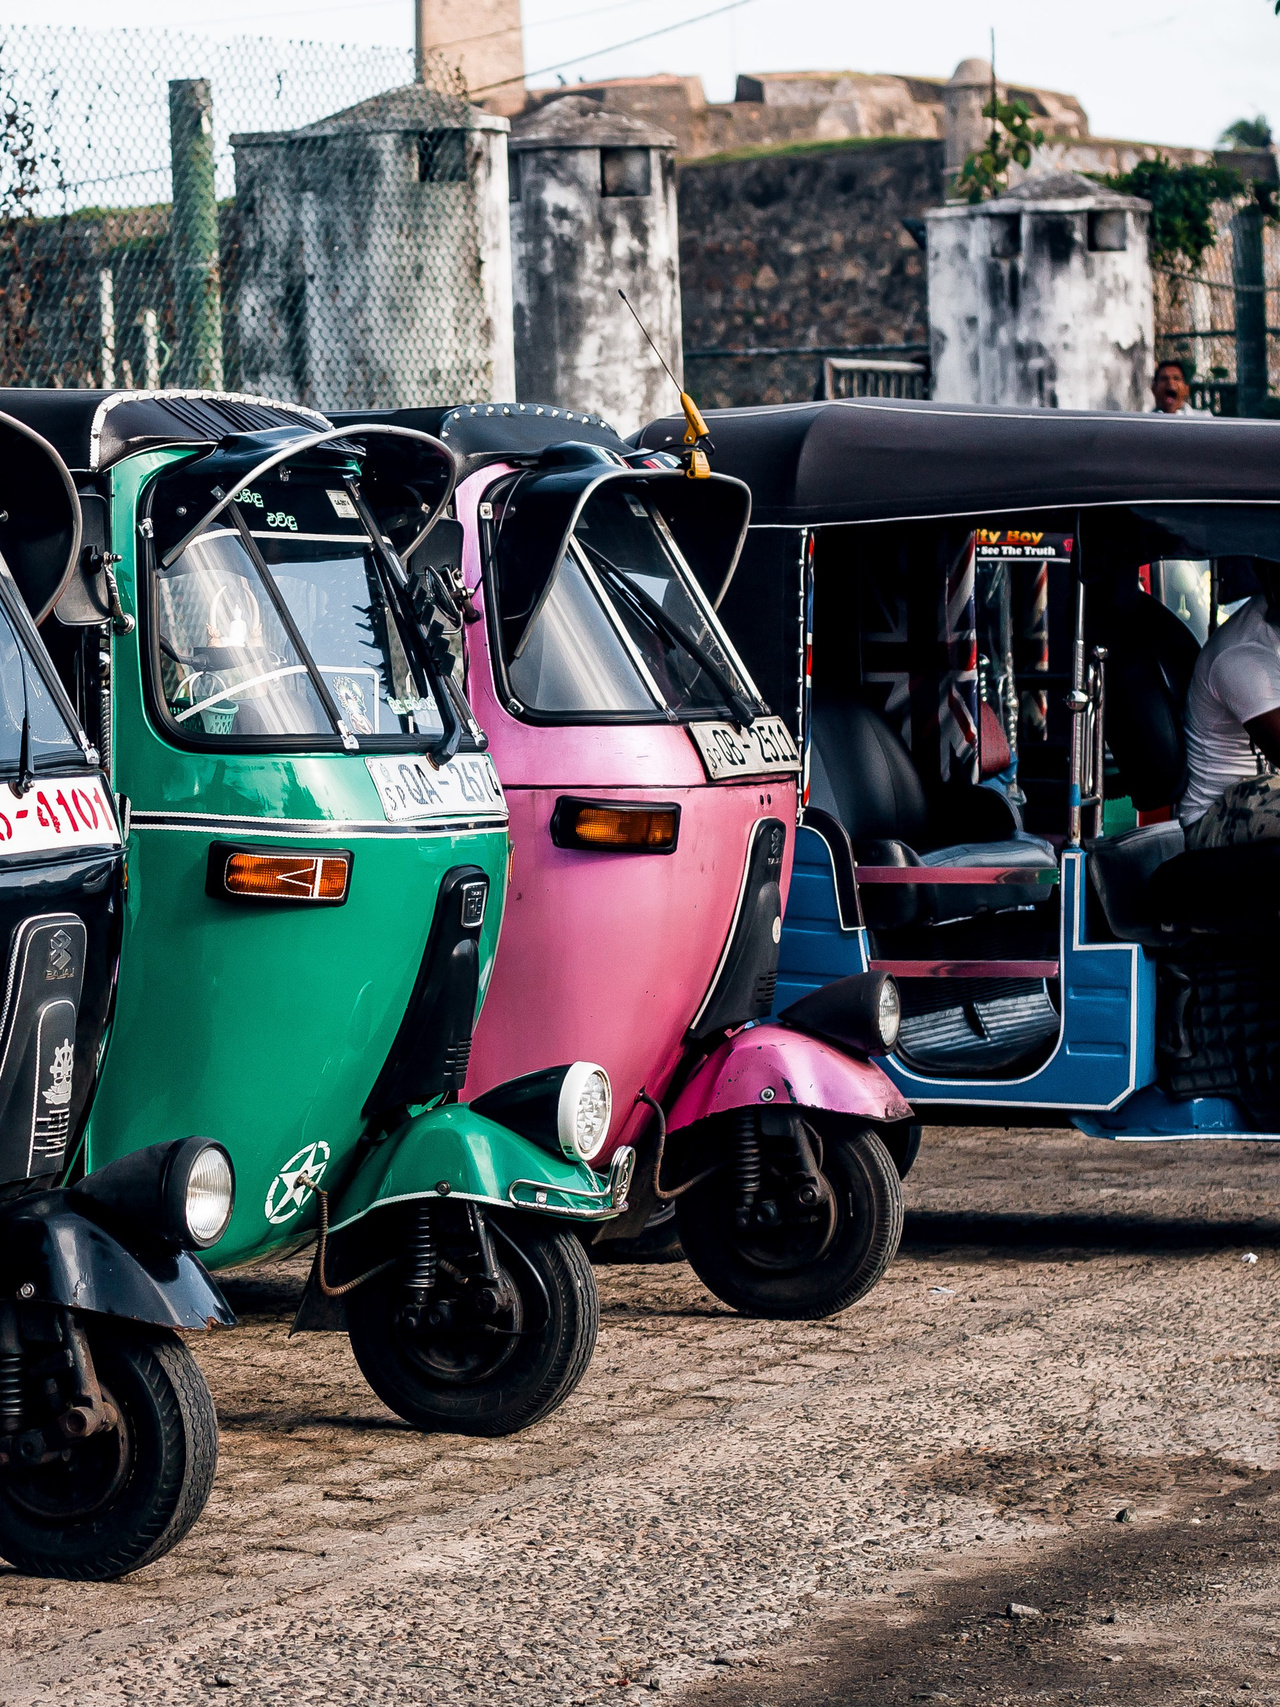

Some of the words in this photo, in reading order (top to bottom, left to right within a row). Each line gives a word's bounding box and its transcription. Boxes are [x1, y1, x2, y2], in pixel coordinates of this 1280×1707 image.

[1006, 530, 1044, 546] Boy
[980, 545, 1000, 556] See
[1000, 545, 1023, 556] The
[1023, 545, 1057, 556] Truth
